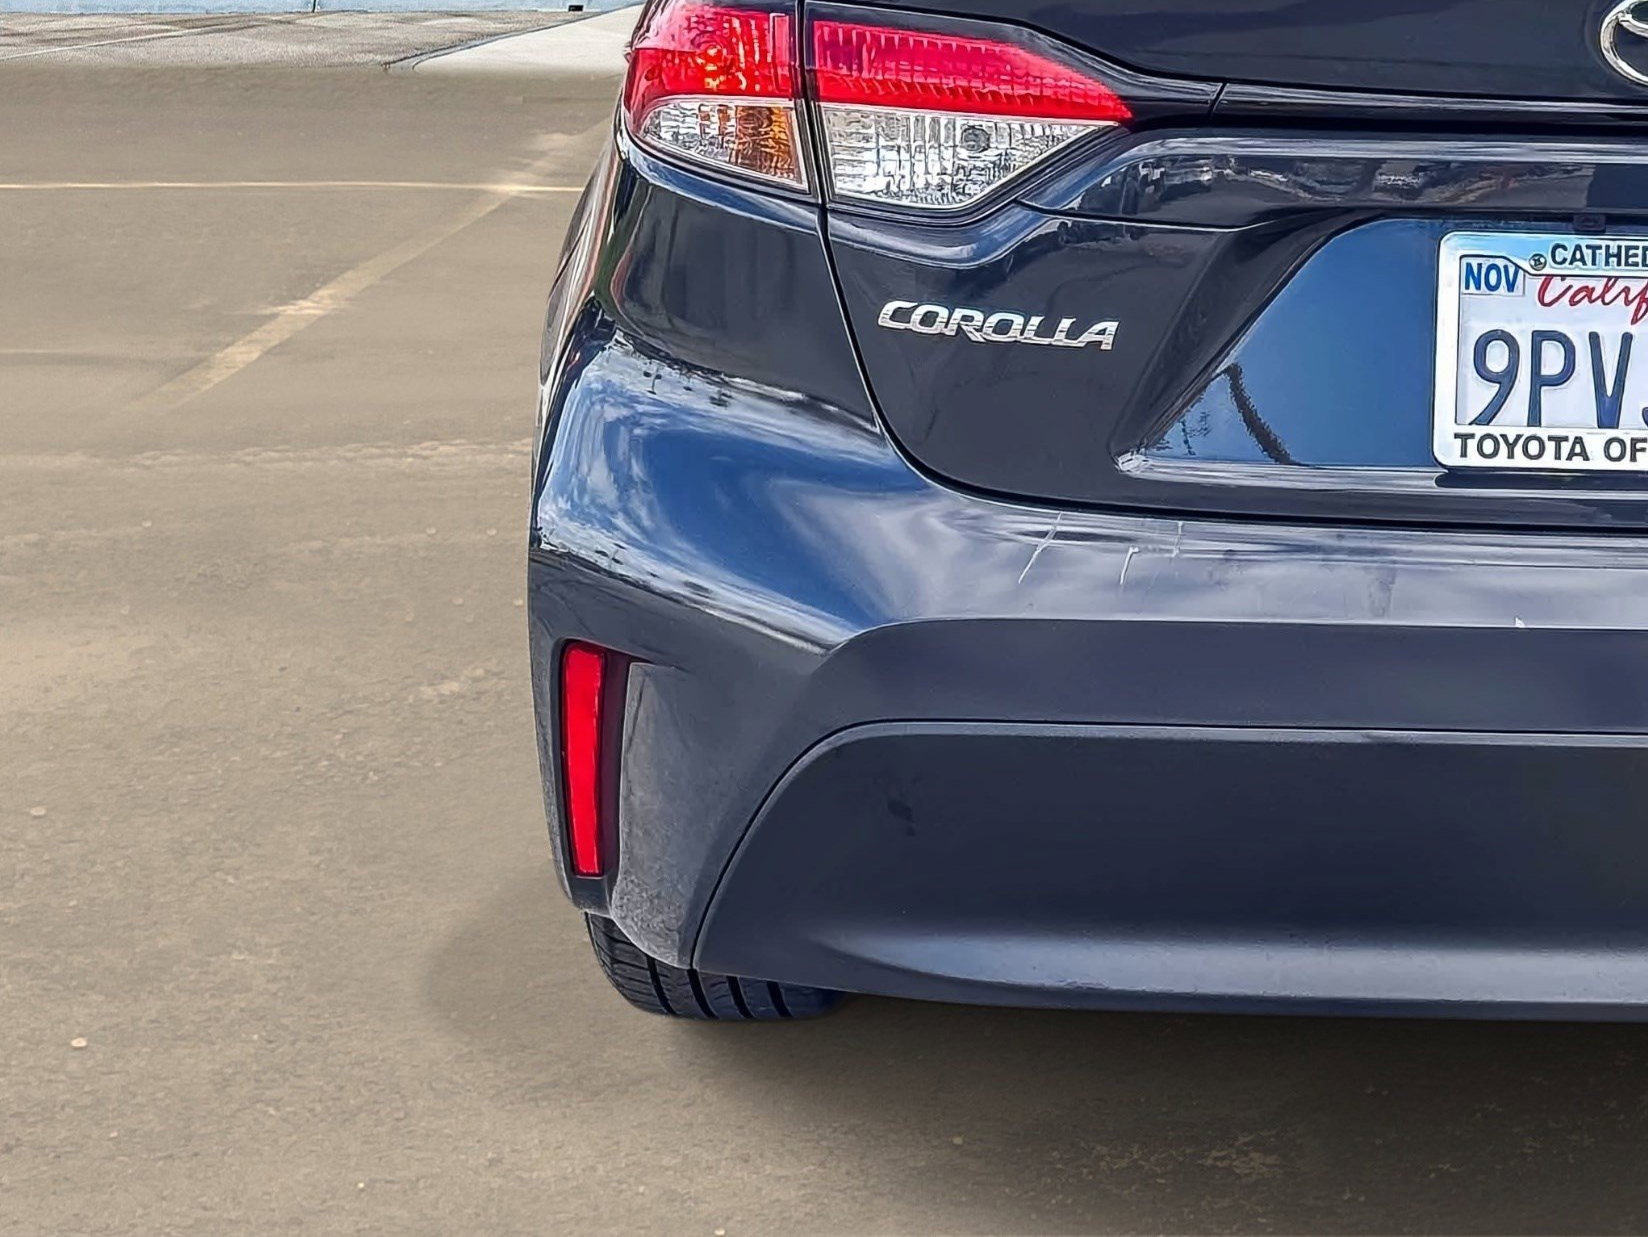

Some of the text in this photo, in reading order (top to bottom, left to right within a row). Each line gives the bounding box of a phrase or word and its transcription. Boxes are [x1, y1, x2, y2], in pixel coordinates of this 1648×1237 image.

[1464, 261, 1520, 293] NOV
[877, 300, 1120, 351] COROLLA
[1454, 432, 1590, 462] TOYOTA
[1603, 436, 1647, 463] OF
